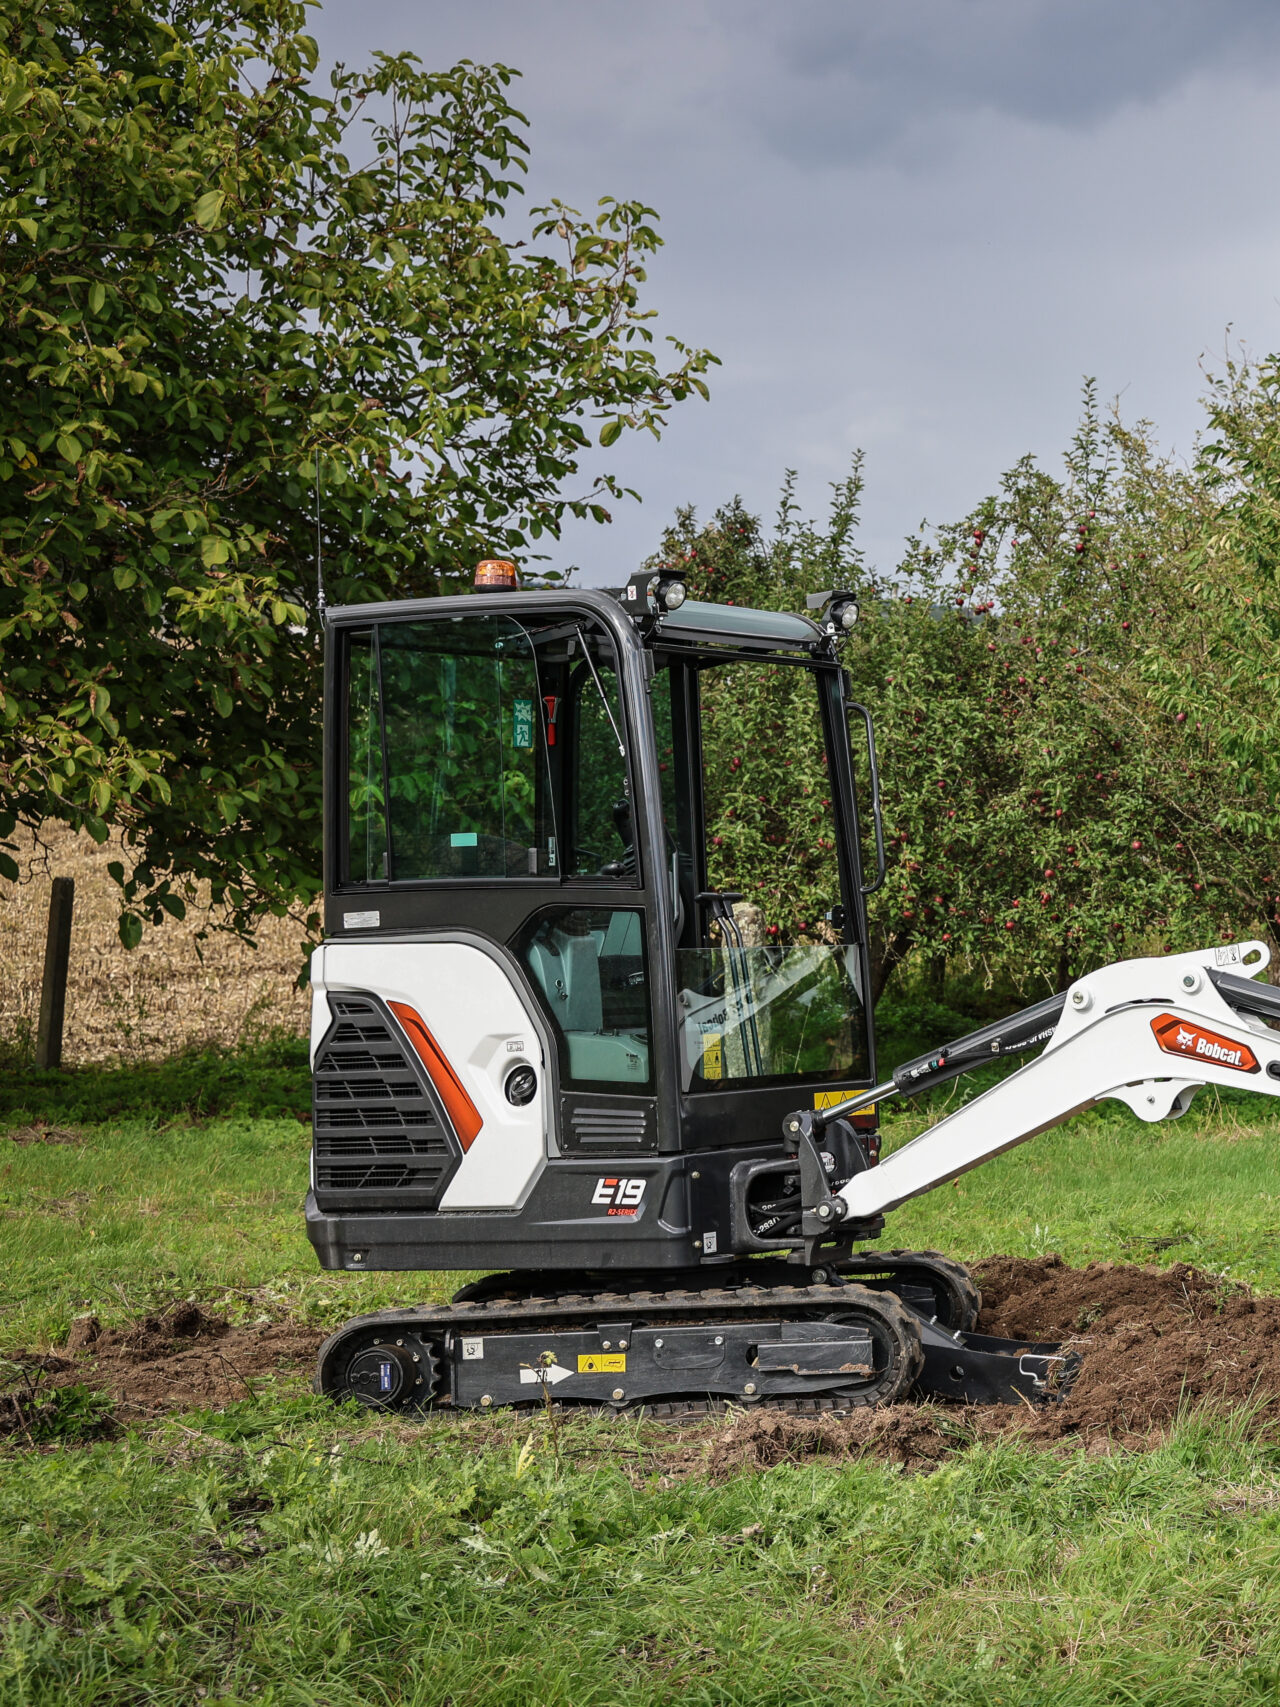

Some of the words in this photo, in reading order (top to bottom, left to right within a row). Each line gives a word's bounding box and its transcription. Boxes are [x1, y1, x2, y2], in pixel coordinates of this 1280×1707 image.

[1195, 1038, 1243, 1066] Bobcat
[591, 1178, 647, 1205] E19
[607, 1208, 638, 1217] R2-SERIES
